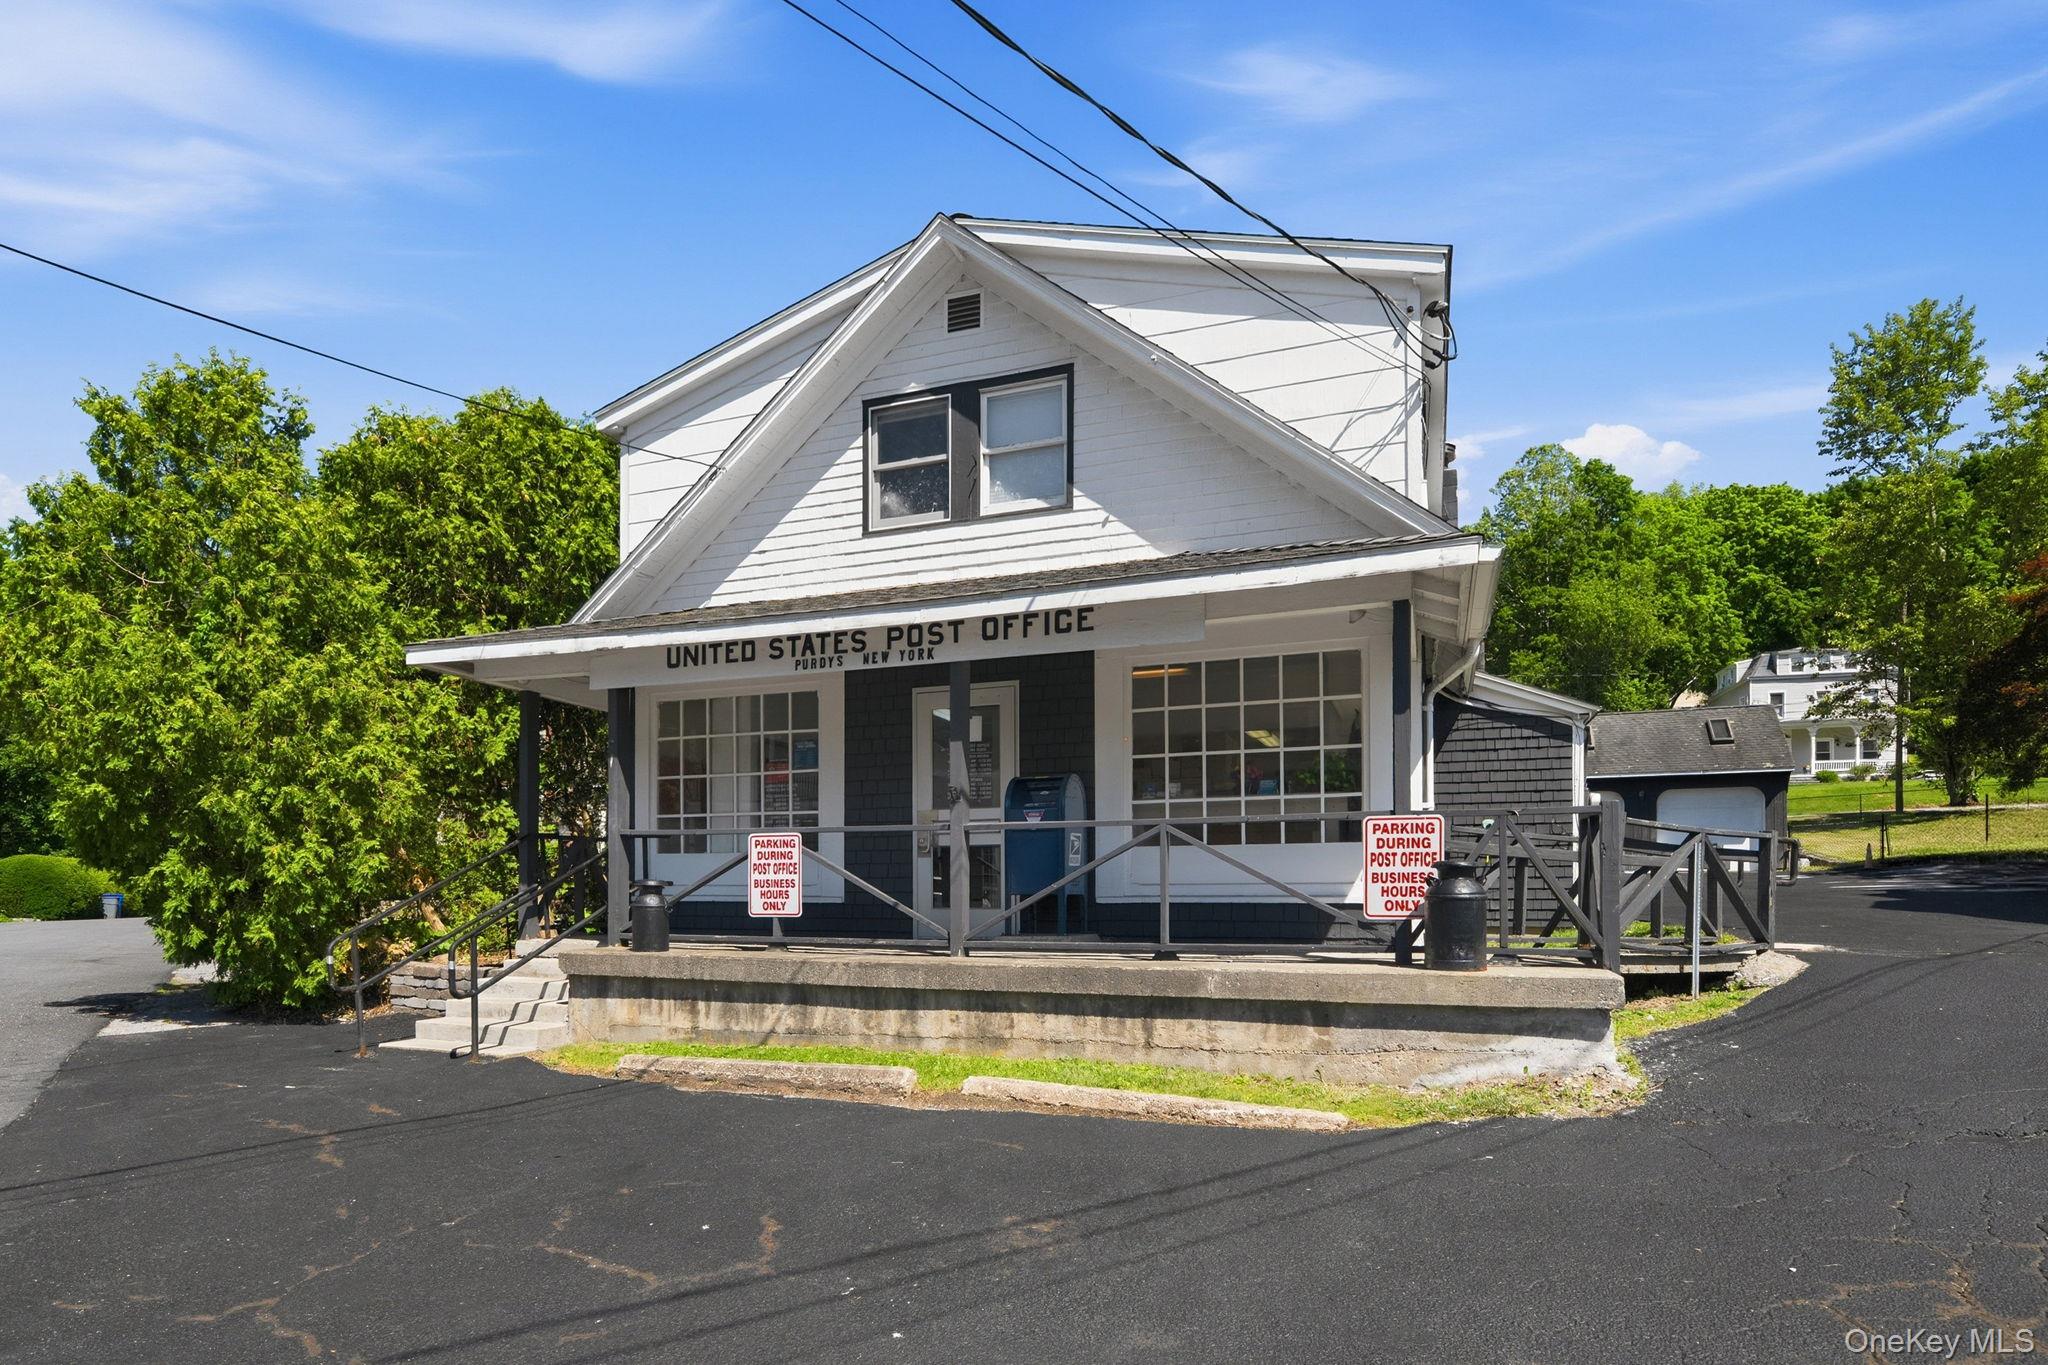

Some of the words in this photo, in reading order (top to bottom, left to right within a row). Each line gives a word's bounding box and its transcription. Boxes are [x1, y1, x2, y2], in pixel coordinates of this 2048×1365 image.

[666, 639, 756, 669] UNITED
[768, 629, 867, 660] STATES
[886, 619, 965, 651] POST
[981, 606, 1095, 641] OFFICE
[794, 658, 844, 672] PURDYS
[862, 650, 889, 666] NEW
[899, 647, 935, 663] YORK
[1372, 823, 1436, 834] PARKING
[754, 839, 796, 849] PARKING
[1376, 837, 1431, 849] DURING
[757, 851, 793, 861] DURING
[1370, 852, 1397, 867] POST
[1400, 852, 1437, 867] OFFICE
[753, 863, 771, 875] POST
[773, 862, 797, 875] OFFICE
[754, 878, 796, 888] BUSINESS
[760, 890, 790, 899] HOURS
[1381, 886, 1425, 897] HOURS
[762, 901, 787, 911] ONLY
[1384, 900, 1421, 911] ONLY
